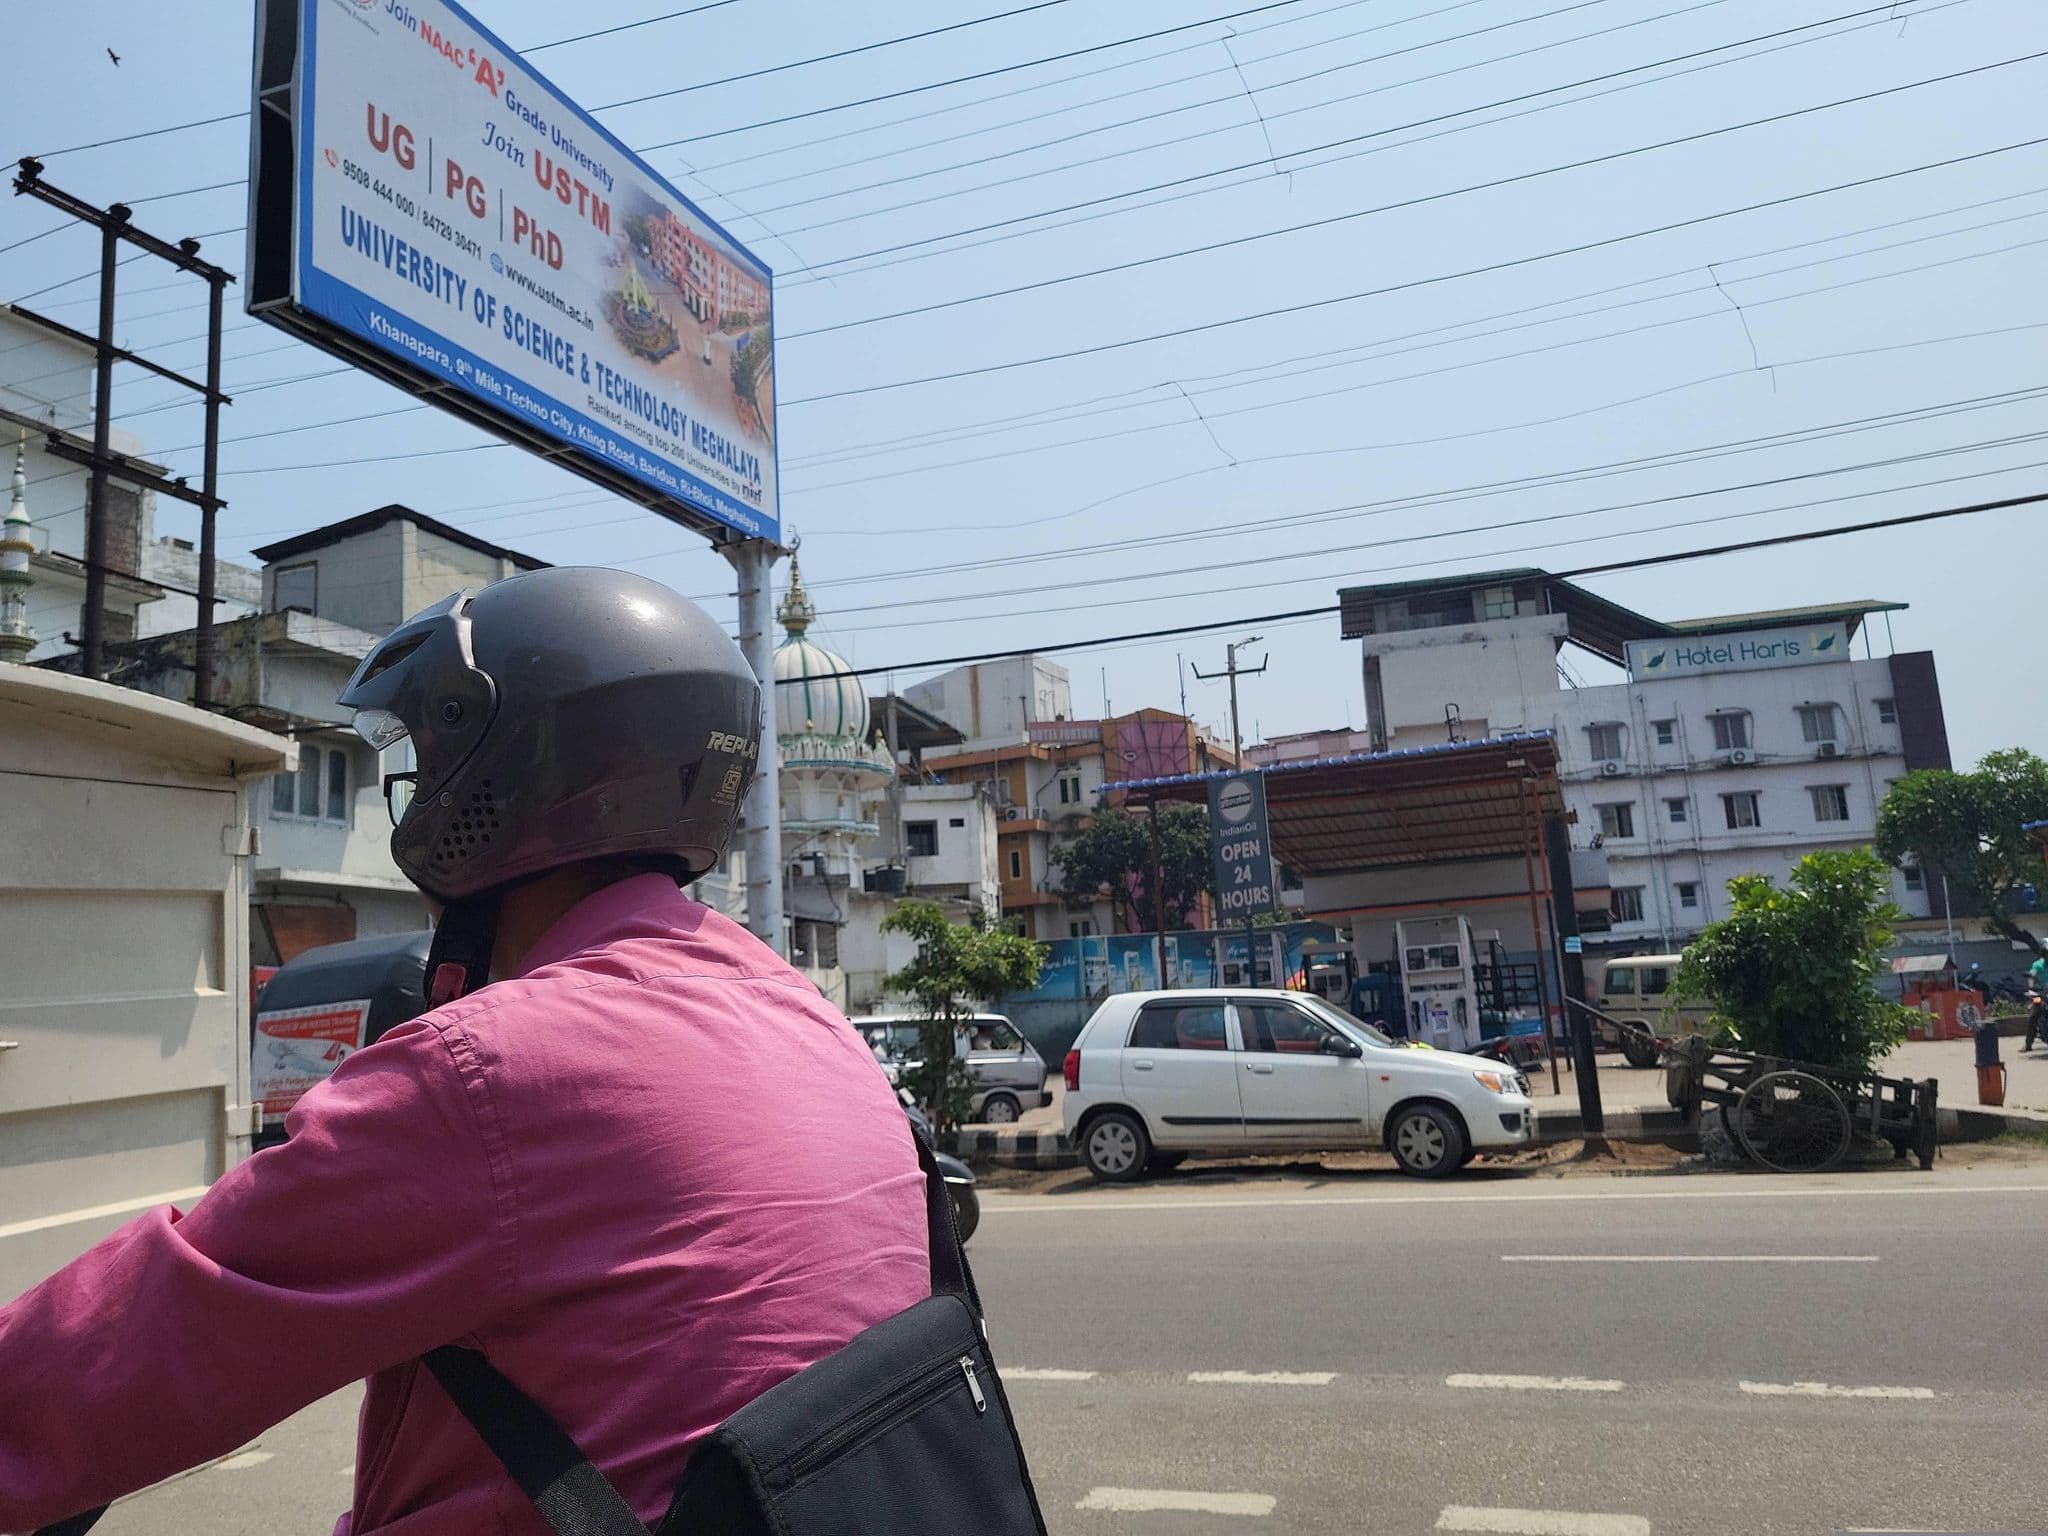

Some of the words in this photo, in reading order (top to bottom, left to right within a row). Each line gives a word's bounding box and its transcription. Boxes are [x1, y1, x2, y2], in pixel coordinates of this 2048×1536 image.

[385, 0, 417, 32] Join
[420, 20, 464, 69] NAAC
[506, 89, 548, 136] Grade
[551, 124, 614, 193] University
[343, 159, 369, 189] 9508
[373, 179, 393, 203] 444
[395, 193, 415, 217] 000
[423, 210, 452, 241] 84729
[455, 231, 482, 261] 30471
[367, 103, 415, 171] UG
[446, 158, 487, 219] PG
[513, 205, 563, 271] PhD
[482, 121, 525, 168] Join
[535, 150, 611, 236] USTM
[506, 264, 595, 332] www.ustm.ac.in
[341, 204, 467, 312] UNIVERSITY
[474, 287, 496, 329] OF
[503, 305, 575, 376] SCIENCE
[580, 352, 591, 385] &
[595, 361, 687, 442] TECHNOLOGY
[691, 419, 761, 487] MEGHALAYA
[370, 311, 453, 373] Khanapara,
[475, 367, 501, 397] Mile
[504, 384, 549, 421] Techno
[1675, 643, 1734, 667] Hotel
[1220, 821, 1257, 837] IndianOil
[1221, 839, 1261, 863] OPEN
[1221, 886, 1270, 910] HOURS
[1234, 863, 1252, 884] 24
